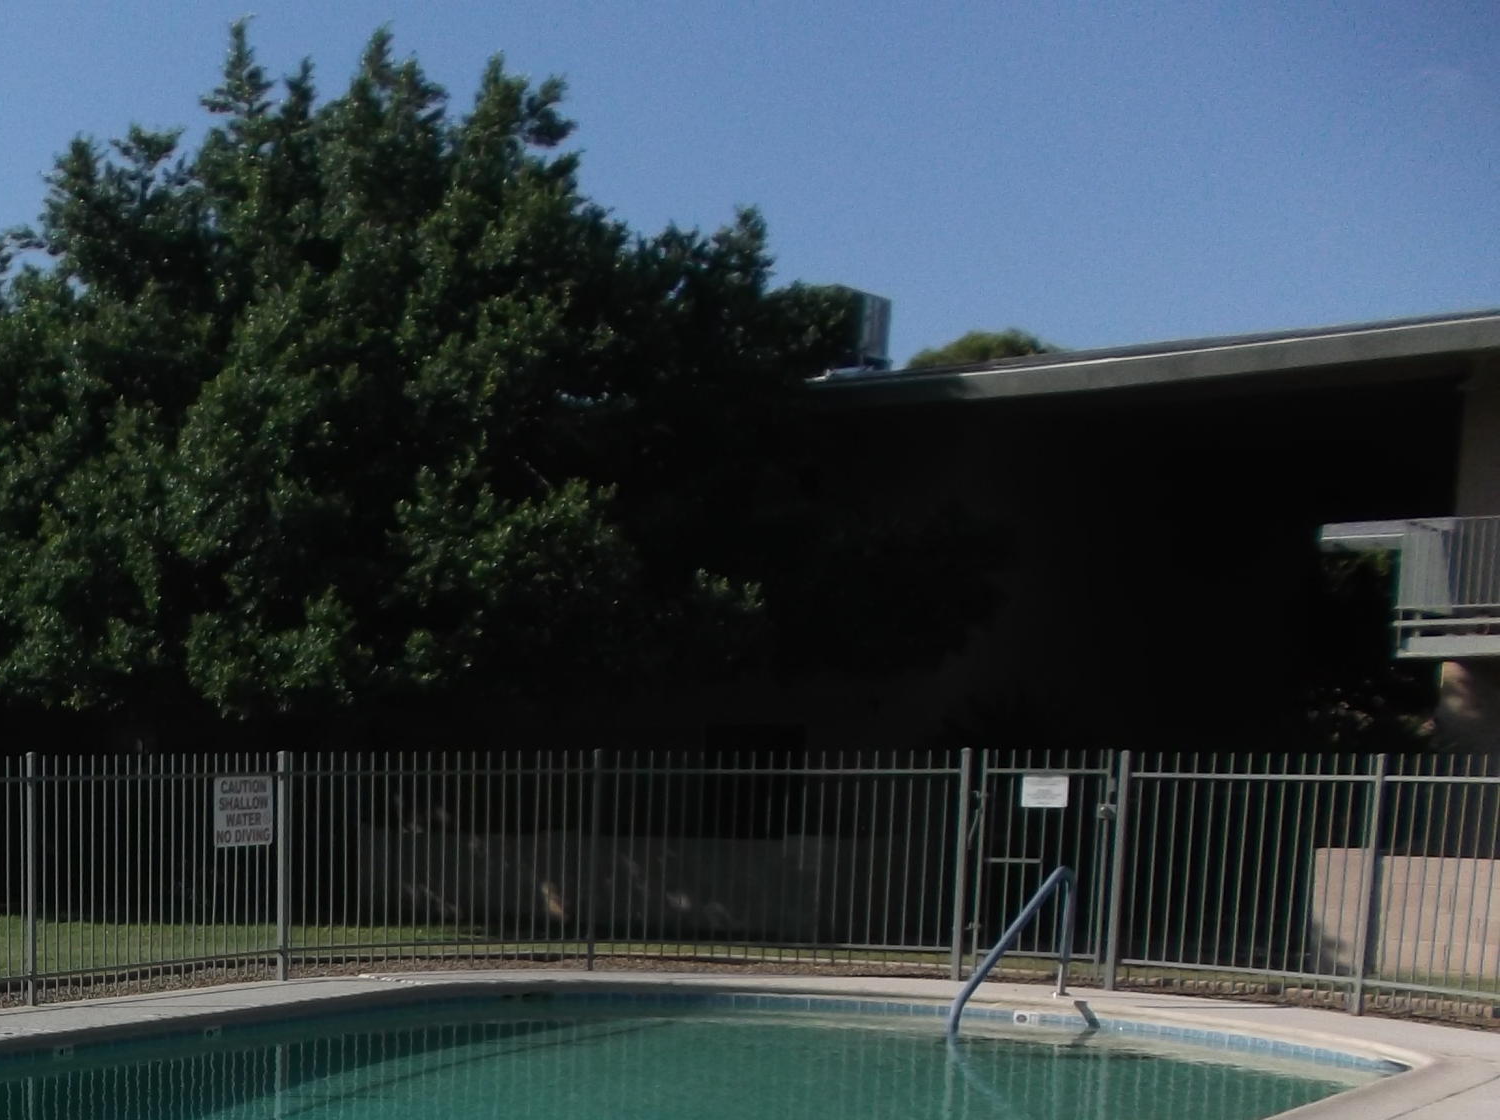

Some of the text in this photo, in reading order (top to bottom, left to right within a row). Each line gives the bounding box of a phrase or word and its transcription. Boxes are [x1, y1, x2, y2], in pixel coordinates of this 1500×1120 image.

[220, 780, 267, 794] CAUTION
[219, 796, 269, 811] SHALLOW
[226, 812, 262, 827] WATER
[216, 828, 271, 844] NO DIVING
